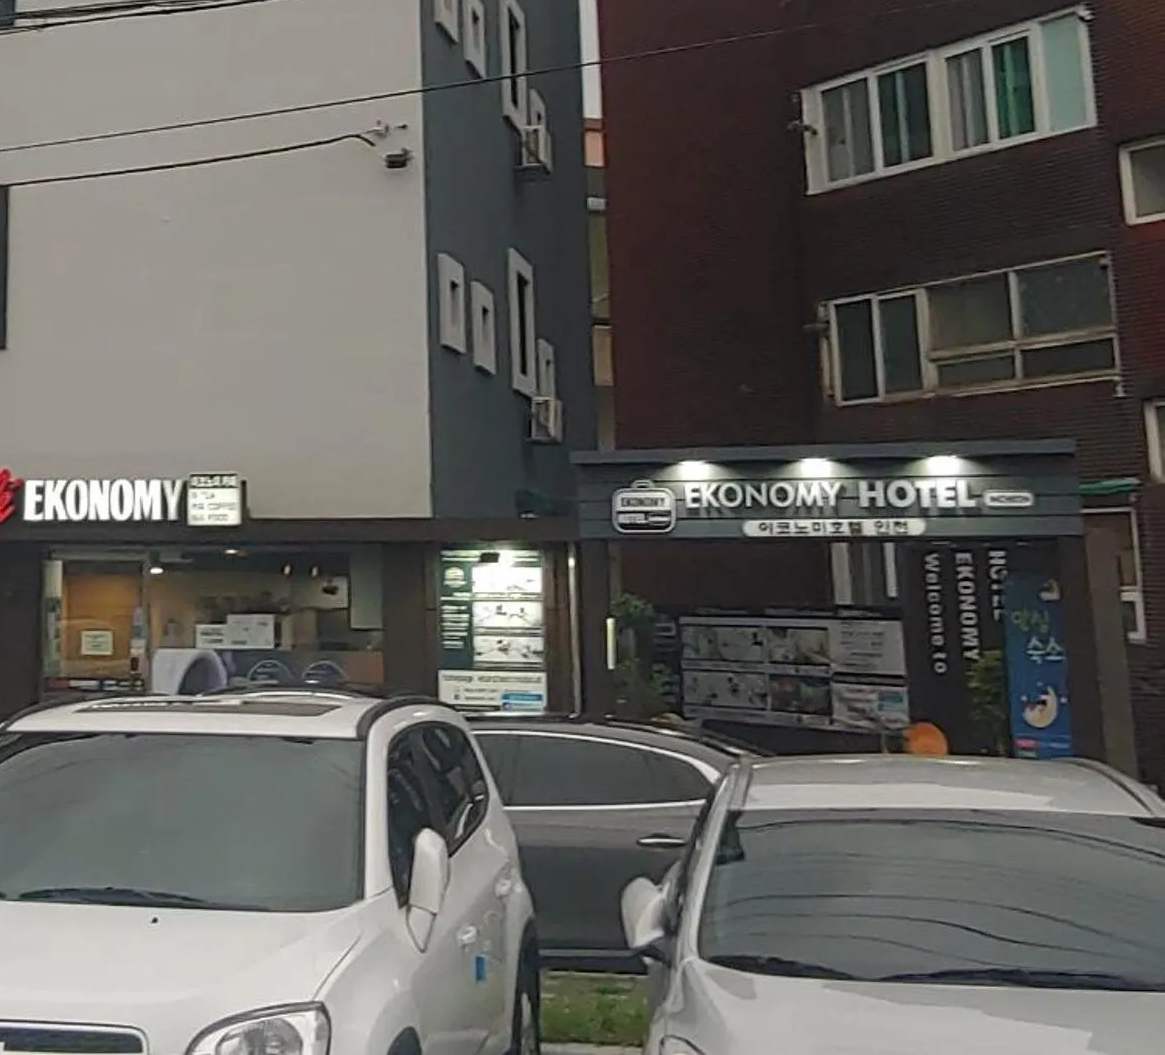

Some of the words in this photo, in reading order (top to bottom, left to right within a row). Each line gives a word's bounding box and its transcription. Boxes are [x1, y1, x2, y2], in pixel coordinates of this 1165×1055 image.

[23, 479, 184, 521] EKONOMY
[684, 481, 843, 508] EKONOMY
[859, 480, 977, 507] HOTEL
[758, 521, 864, 538] 이코노미호텔
[873, 520, 909, 537] 인천
[924, 552, 943, 646] Welcome
[955, 552, 979, 660] EKONOMY
[932, 651, 947, 674] to
[1026, 635, 1067, 665] 숙소
